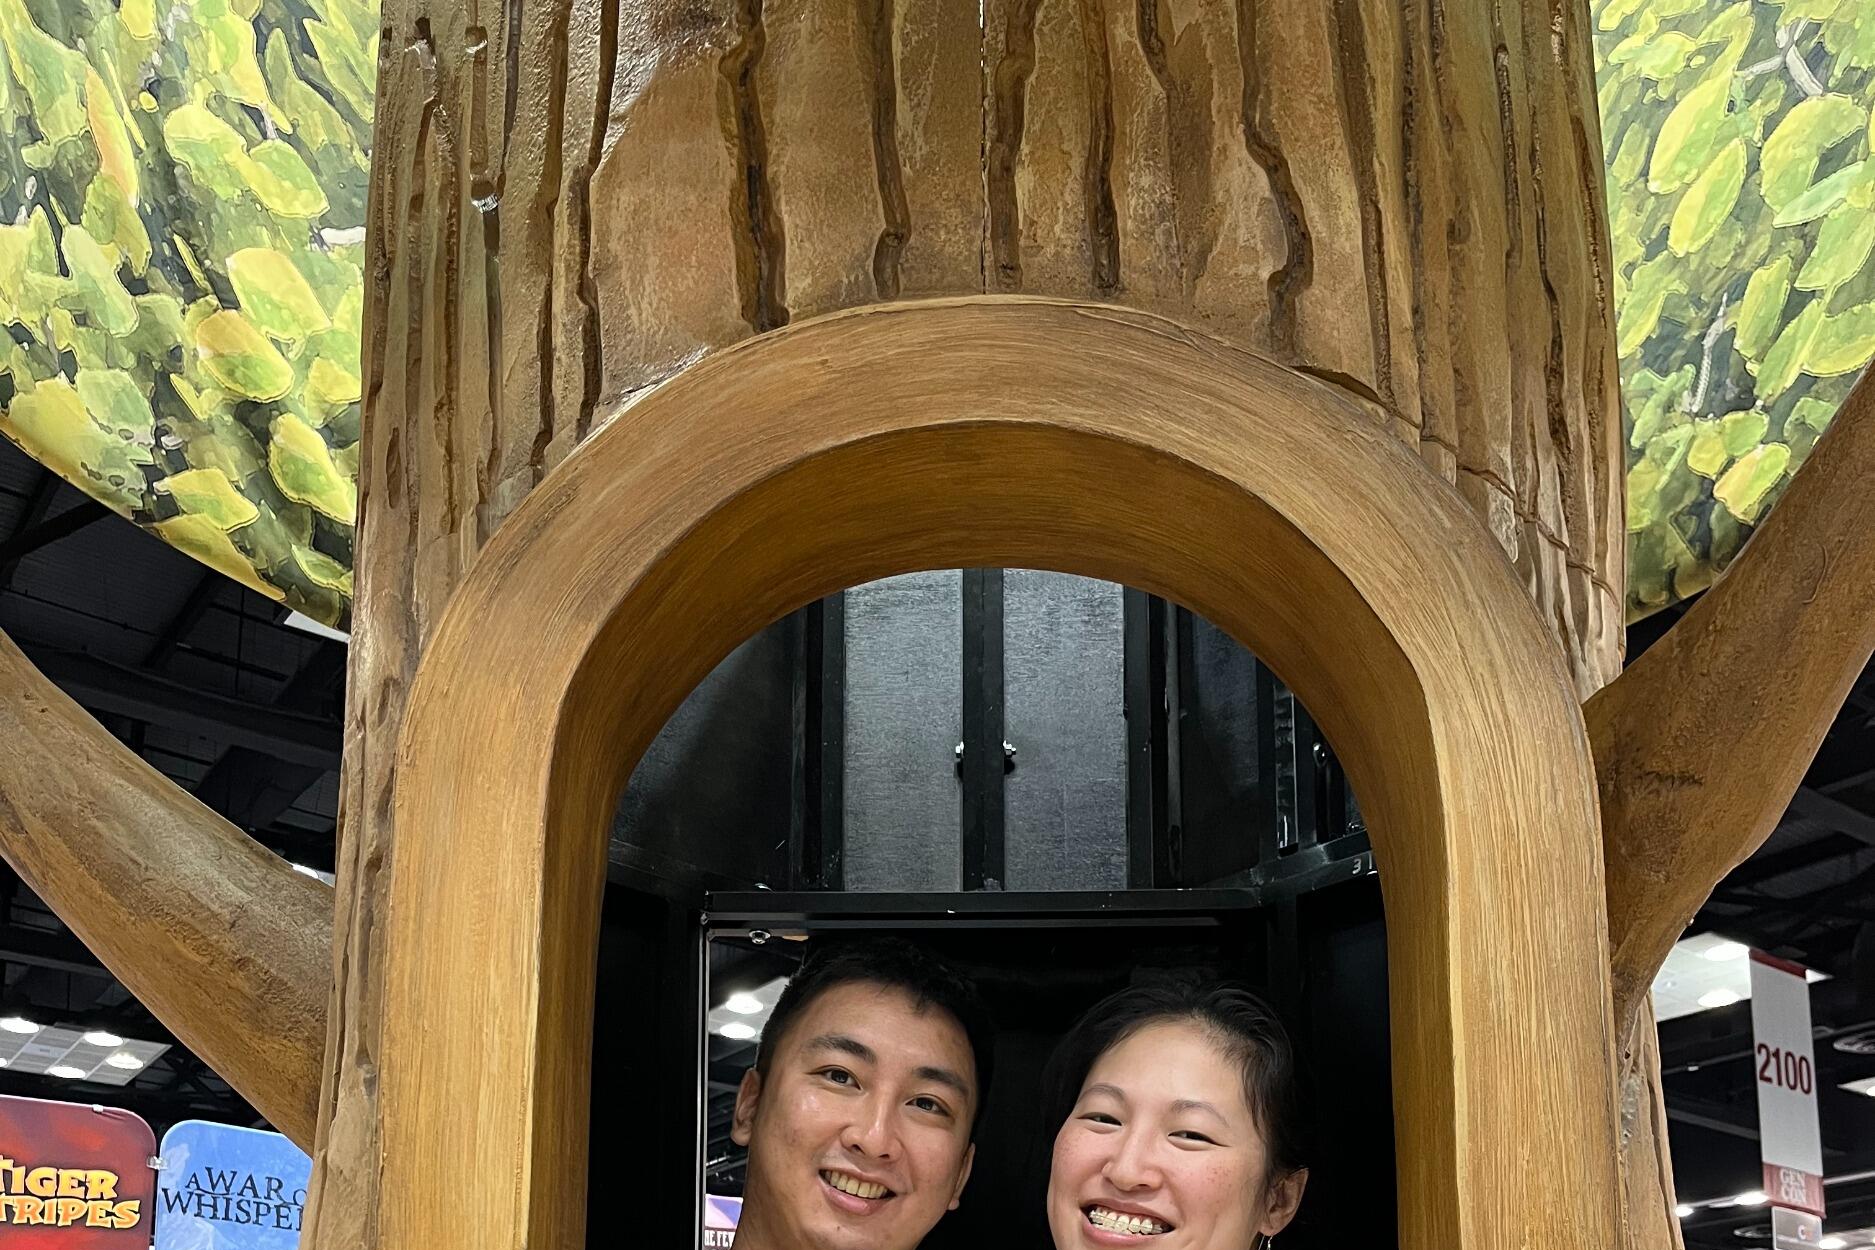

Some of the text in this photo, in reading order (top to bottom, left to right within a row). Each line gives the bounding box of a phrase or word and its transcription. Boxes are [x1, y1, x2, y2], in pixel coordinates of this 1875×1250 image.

[1757, 1043, 1812, 1095] 2100
[185, 1172, 201, 1190] A
[205, 1167, 288, 1204] WAR
